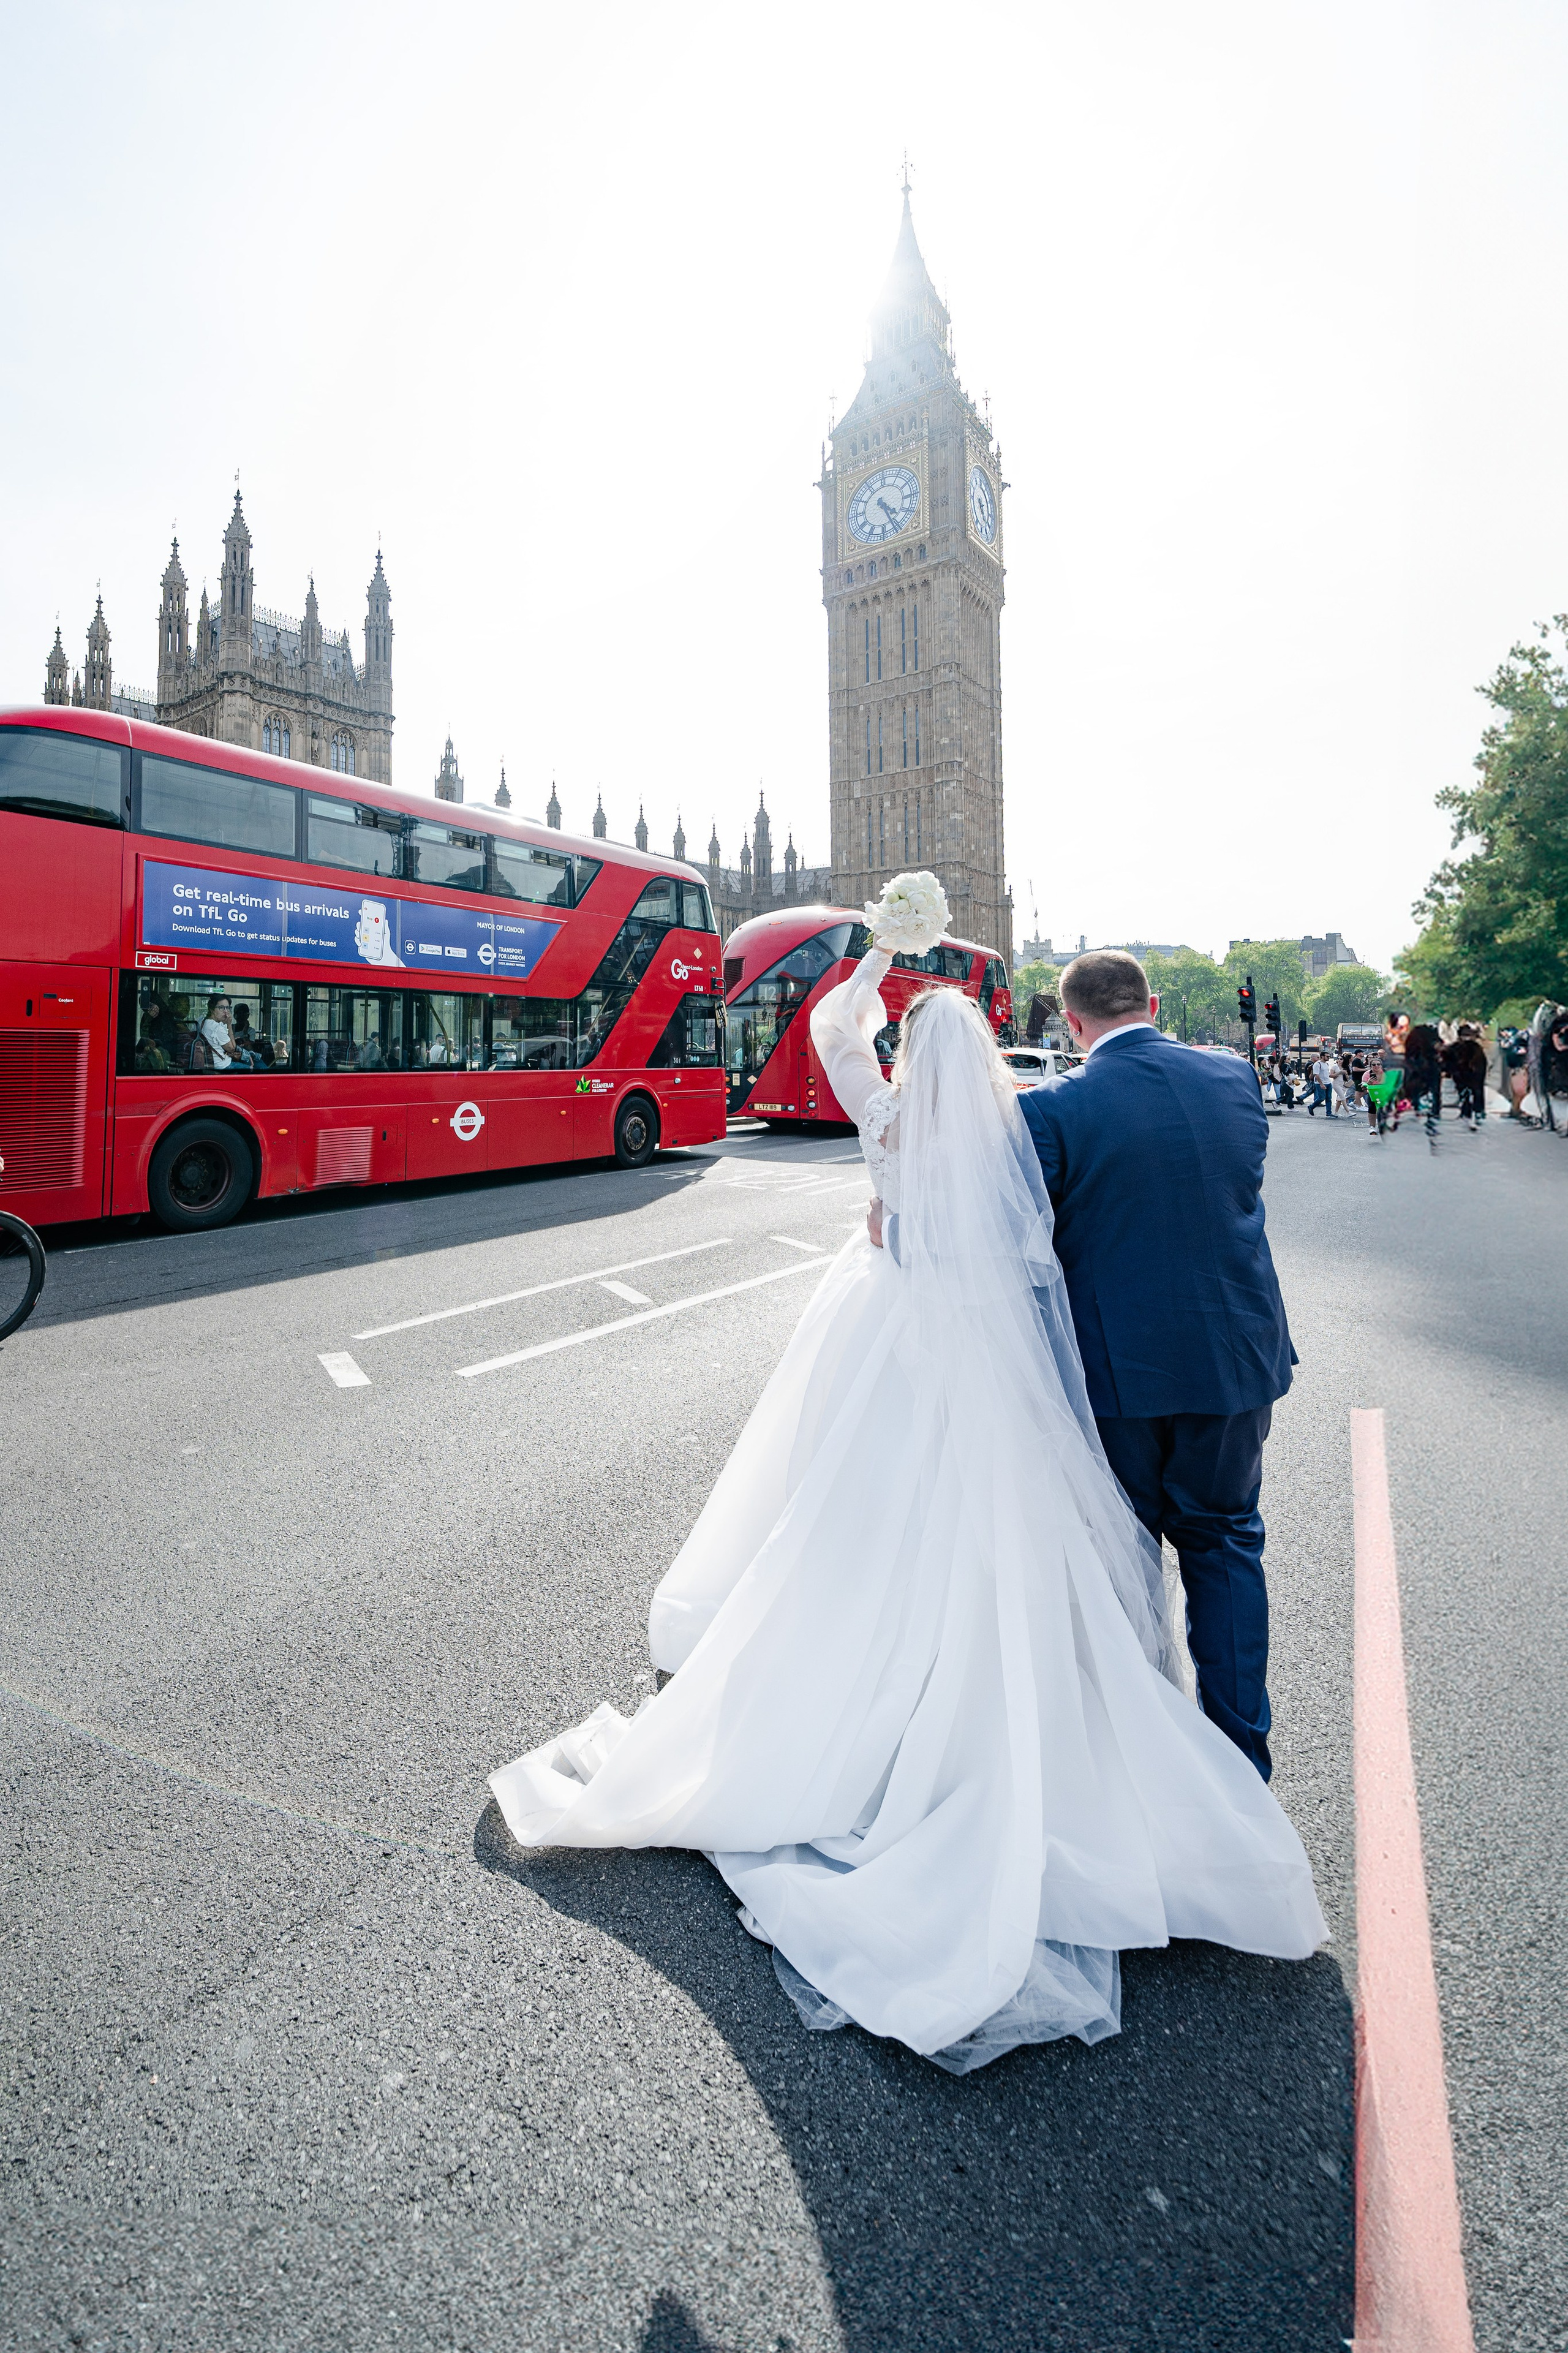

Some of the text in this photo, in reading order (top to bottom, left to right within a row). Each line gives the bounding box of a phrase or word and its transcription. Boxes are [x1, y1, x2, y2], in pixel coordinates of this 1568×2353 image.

[173, 883, 350, 919] Get real-time bus arrivals
[172, 904, 248, 923] on TfL Go
[172, 923, 211, 934] Download
[319, 939, 337, 947] buses
[477, 921, 495, 930] MAYOR
[504, 926, 525, 934] LONDON
[144, 954, 169, 966] global
[671, 958, 688, 980] Go
[764, 986, 777, 1001] 12
